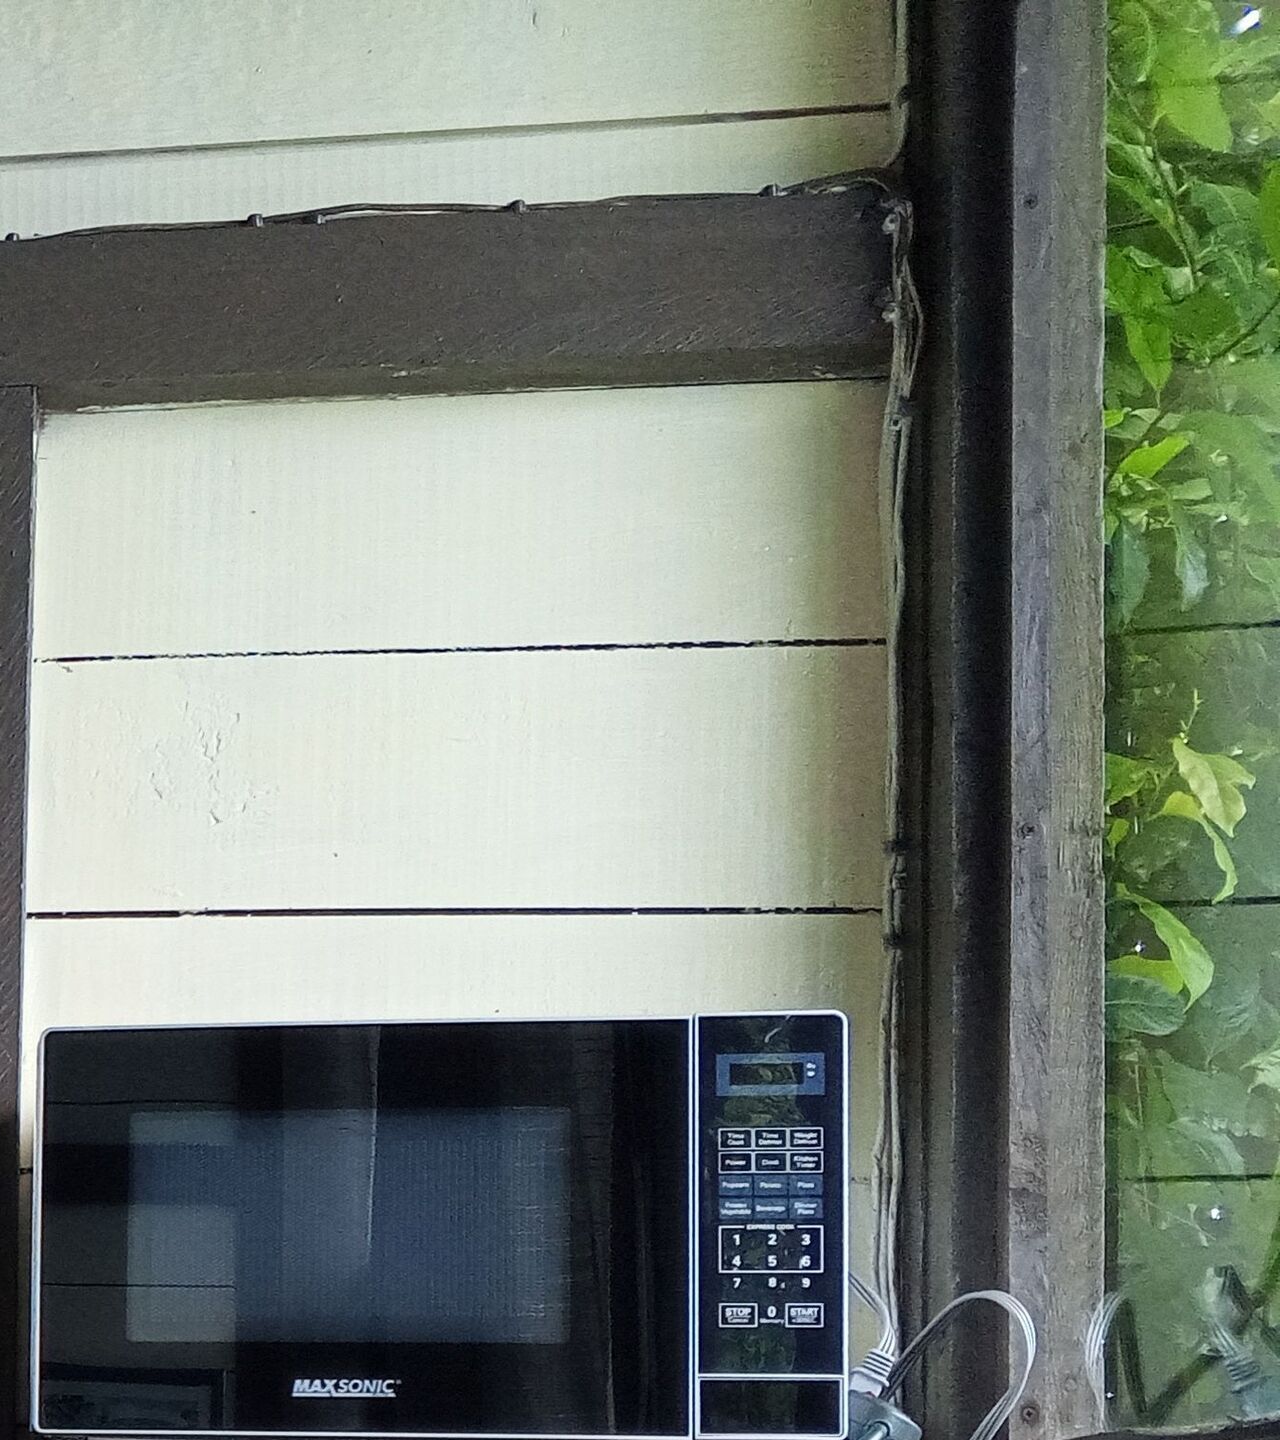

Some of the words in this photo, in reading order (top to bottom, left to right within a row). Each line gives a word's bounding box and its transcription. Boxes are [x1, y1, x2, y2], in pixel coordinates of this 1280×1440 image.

[732, 1234, 740, 1246] 1
[767, 1233, 778, 1246] 2
[801, 1234, 811, 1246] 3
[731, 1255, 741, 1267] 4
[767, 1255, 777, 1267] 5
[801, 1255, 811, 1267] 6
[732, 1277, 741, 1289] 7
[768, 1277, 777, 1289] 8
[801, 1277, 811, 1289] 9
[725, 1307, 752, 1317] STOP
[767, 1305, 777, 1318] 0
[789, 1307, 819, 1317] START
[292, 1379, 396, 1395] MAXSONIC
